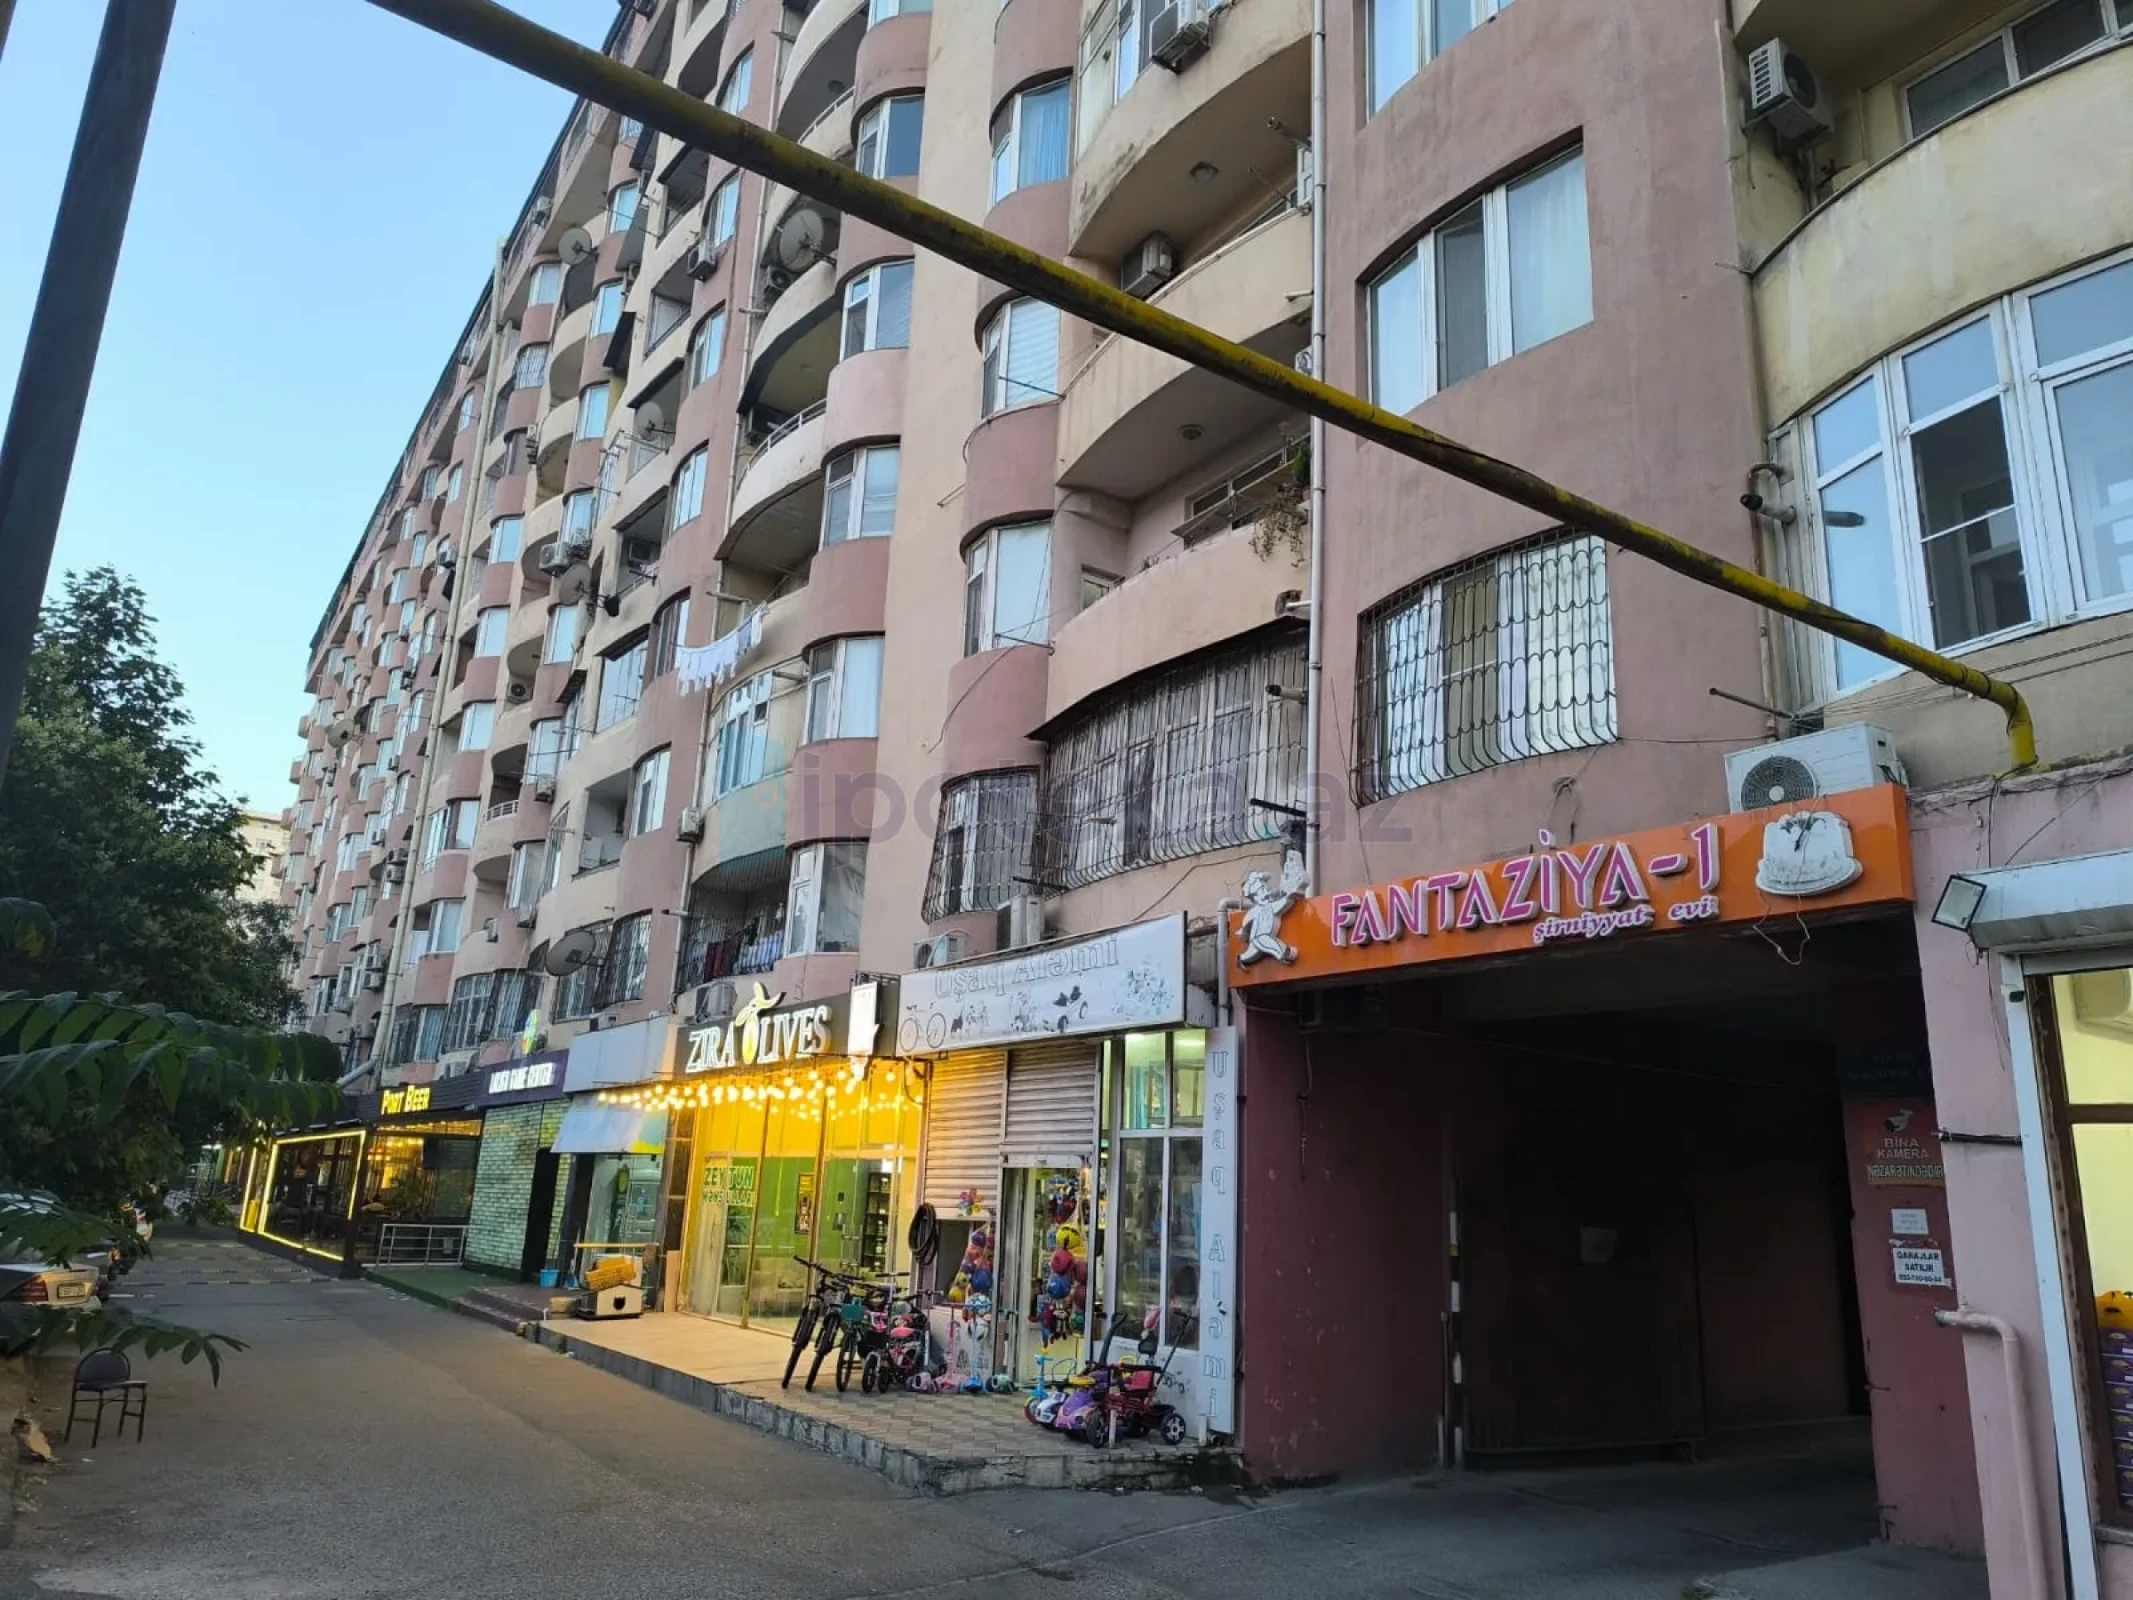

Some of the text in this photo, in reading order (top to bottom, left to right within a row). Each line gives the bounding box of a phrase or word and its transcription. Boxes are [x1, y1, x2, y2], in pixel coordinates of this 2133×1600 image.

[1532, 895, 1718, 943] şirniyyat evi
[685, 1026, 737, 1074] ZIRA
[380, 1085, 431, 1115] PORT BEER
[1877, 1148, 1930, 1160] KAMERA
